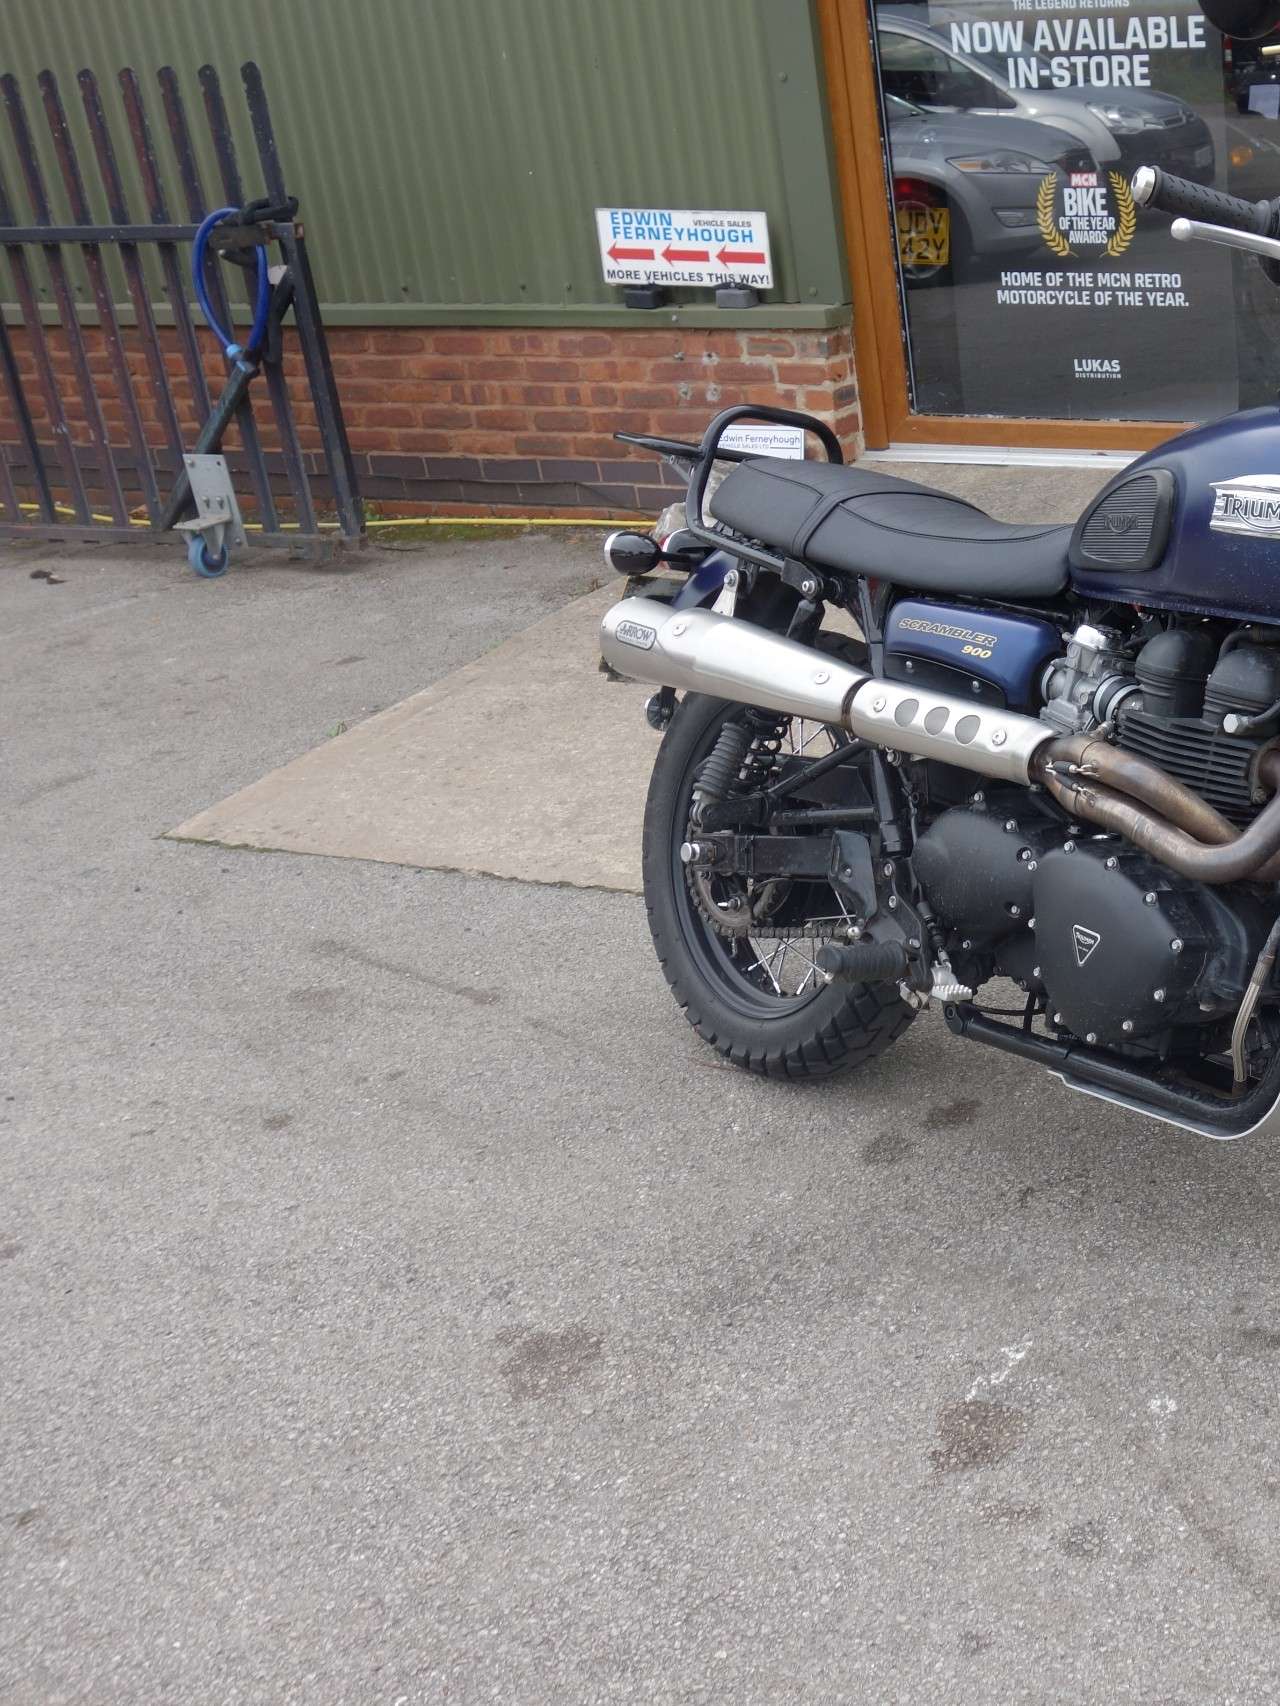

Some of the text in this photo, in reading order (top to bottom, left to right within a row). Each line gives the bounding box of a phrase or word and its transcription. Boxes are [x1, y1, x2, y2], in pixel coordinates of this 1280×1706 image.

[1012, 0, 1130, 10] THE LEGEND RETURNS
[950, 15, 1206, 54] NOW AVAILABLE
[1007, 54, 1151, 89] IN-STORE
[1071, 173, 1098, 186] MCN
[1063, 188, 1108, 216] BIKE
[611, 211, 673, 226] EDWIN
[693, 219, 752, 228] VEHICLE SALES
[1059, 217, 1116, 230] OF THE YEAR
[612, 226, 753, 243] FERNEYHOUGH
[1069, 231, 1108, 244] AWARDS
[607, 270, 770, 285] MORE VEHICLES THIS WAY!
[1001, 271, 1181, 288] HOME OF THE MCN RETRO
[996, 290, 1190, 307] MOTORCYCLE OF THE YEAR.
[1073, 359, 1120, 372] LUKAS
[719, 434, 800, 446] Edwin Ferneyhough
[899, 618, 997, 647] SCRAMBLER
[961, 645, 992, 658] 900
